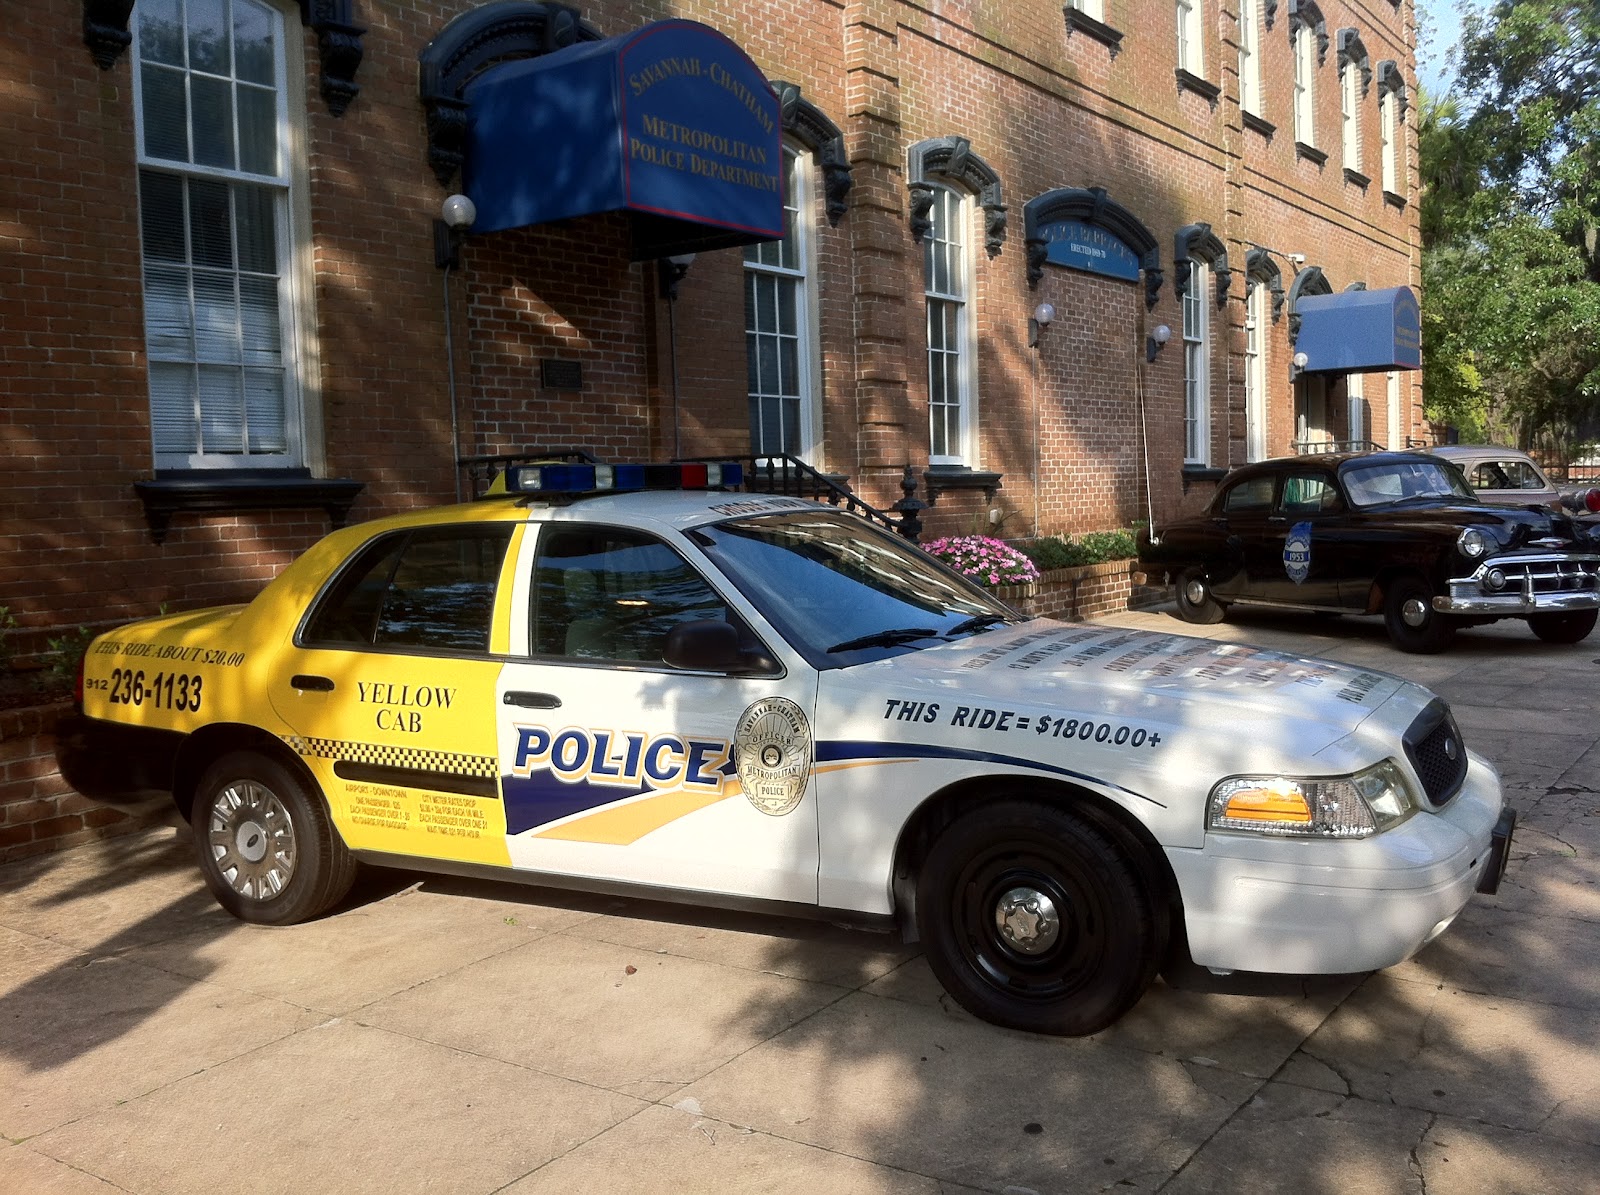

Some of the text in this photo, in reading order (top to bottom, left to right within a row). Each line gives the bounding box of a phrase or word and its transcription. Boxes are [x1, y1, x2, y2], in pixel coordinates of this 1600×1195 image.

[643, 114, 766, 165] METROPOLITAN
[631, 138, 777, 192] POLICE DEPARTMENT
[1289, 552, 1304, 562] 1953
[95, 641, 245, 667] THIS RIDE ABOUT $20.00
[86, 667, 203, 713] 912 236-1133
[357, 681, 457, 709] YELLOW
[376, 708, 422, 733] CAB
[884, 699, 941, 724] THIS
[1035, 714, 1162, 748] $1800.00+
[752, 731, 792, 745] OFFICER
[512, 722, 731, 796] POLICE
[747, 765, 797, 780] METROPOLITAN
[761, 786, 785, 796] POLICE
